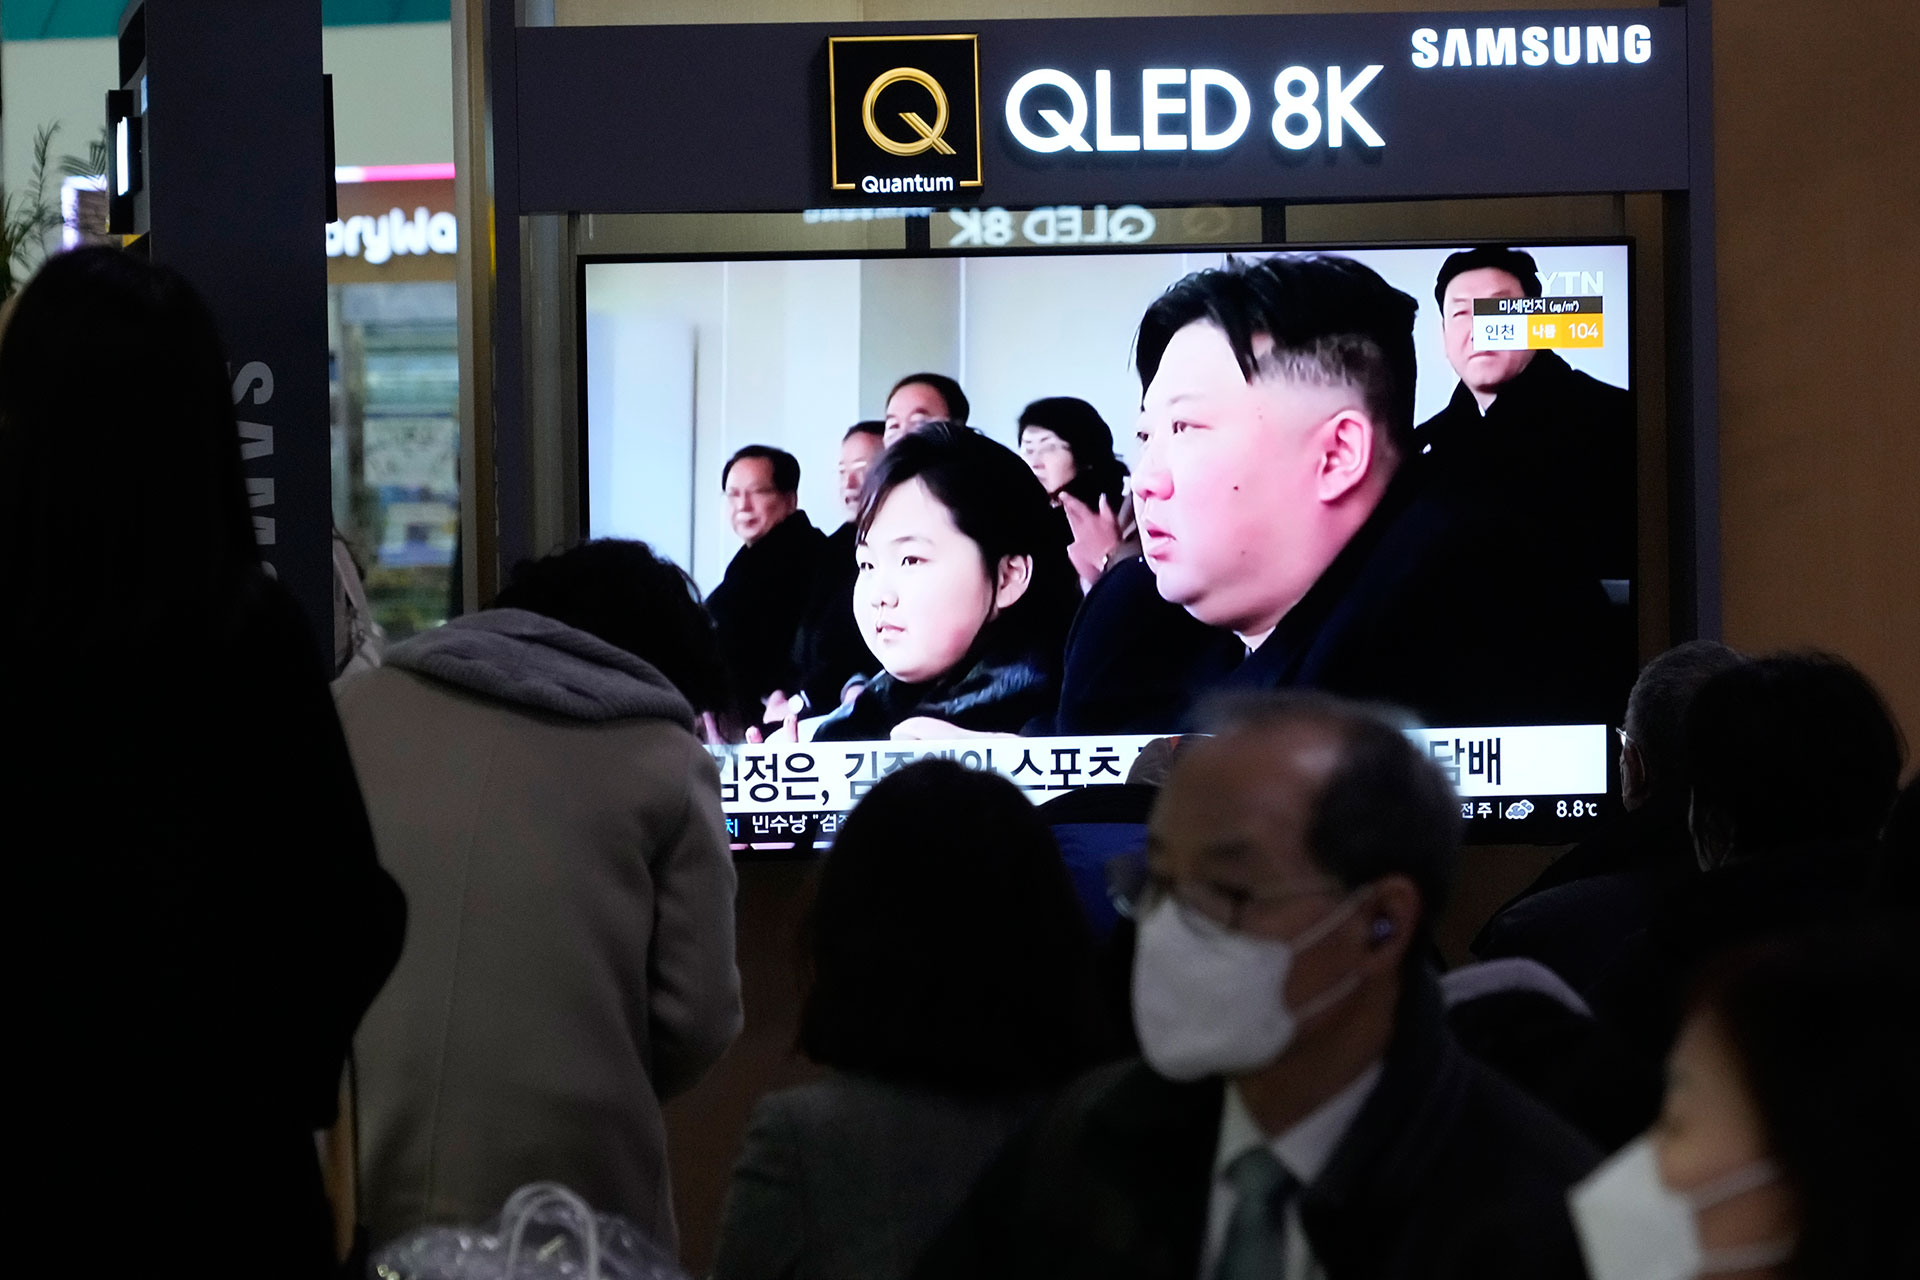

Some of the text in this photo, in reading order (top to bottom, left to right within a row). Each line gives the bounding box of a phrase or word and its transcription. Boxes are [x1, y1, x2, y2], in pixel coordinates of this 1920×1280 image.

[1411, 25, 1652, 68] SAMSUNG
[862, 67, 957, 156] Q
[1005, 65, 1386, 153] QLED 8K
[861, 174, 954, 193] Quantum
[1535, 271, 1604, 295] YTN
[1498, 299, 1546, 314] 미세먼지
[1485, 323, 1515, 341] 인천
[1568, 322, 1599, 339] 104
[1010, 746, 1124, 790] 스포츠
